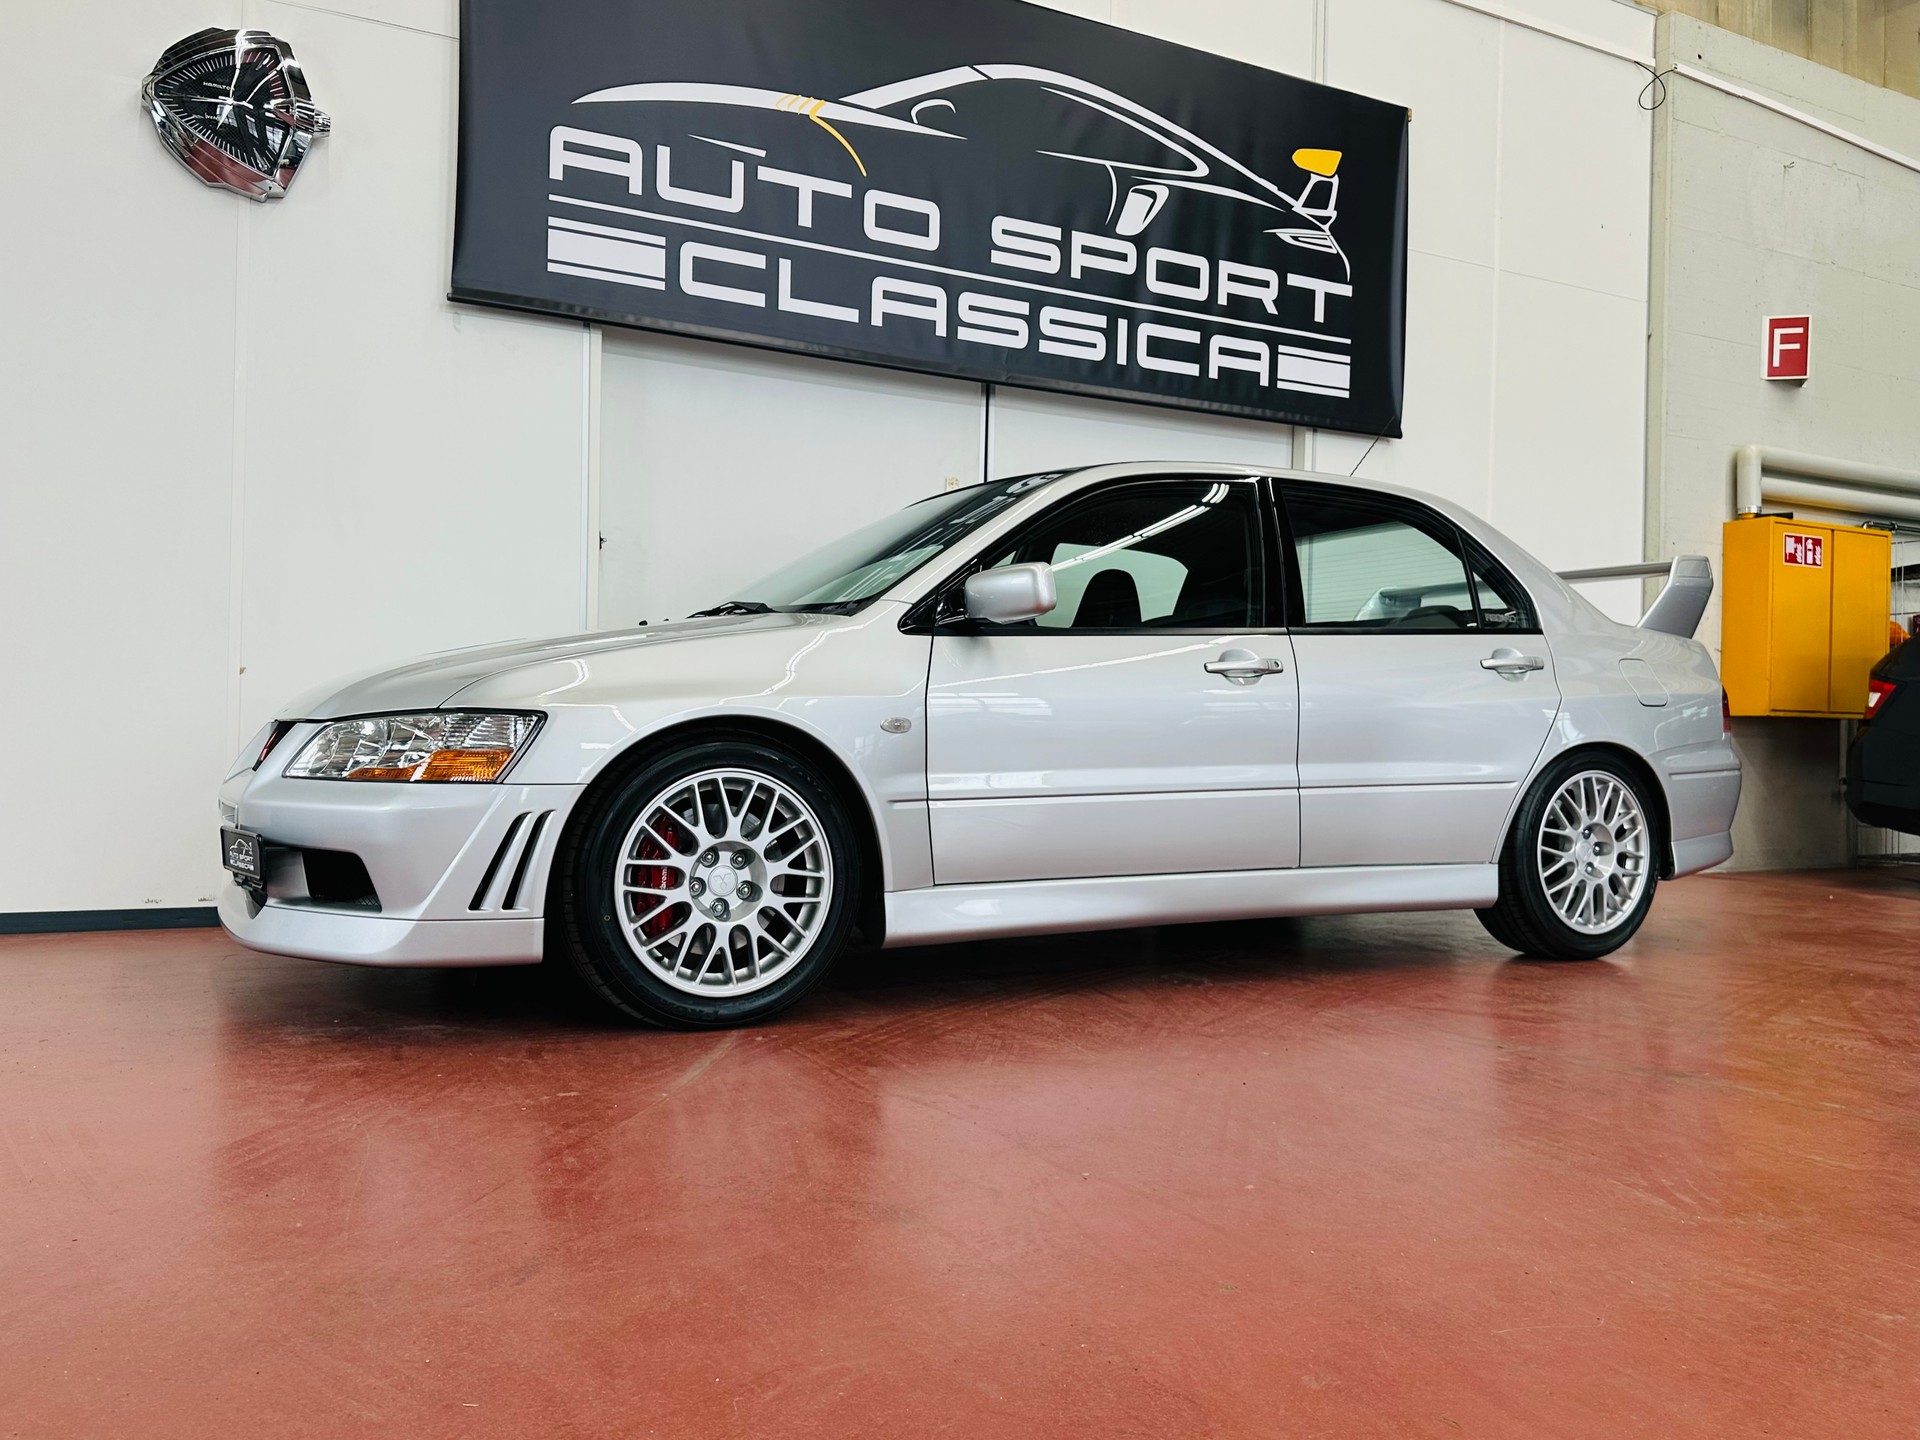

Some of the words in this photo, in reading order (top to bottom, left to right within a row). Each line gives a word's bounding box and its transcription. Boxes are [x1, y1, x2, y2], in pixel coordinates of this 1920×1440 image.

[549, 126, 941, 251] AUTO
[991, 216, 1353, 324] SPORT
[680, 242, 1270, 387] CLASSICA
[1773, 327, 1804, 368] F
